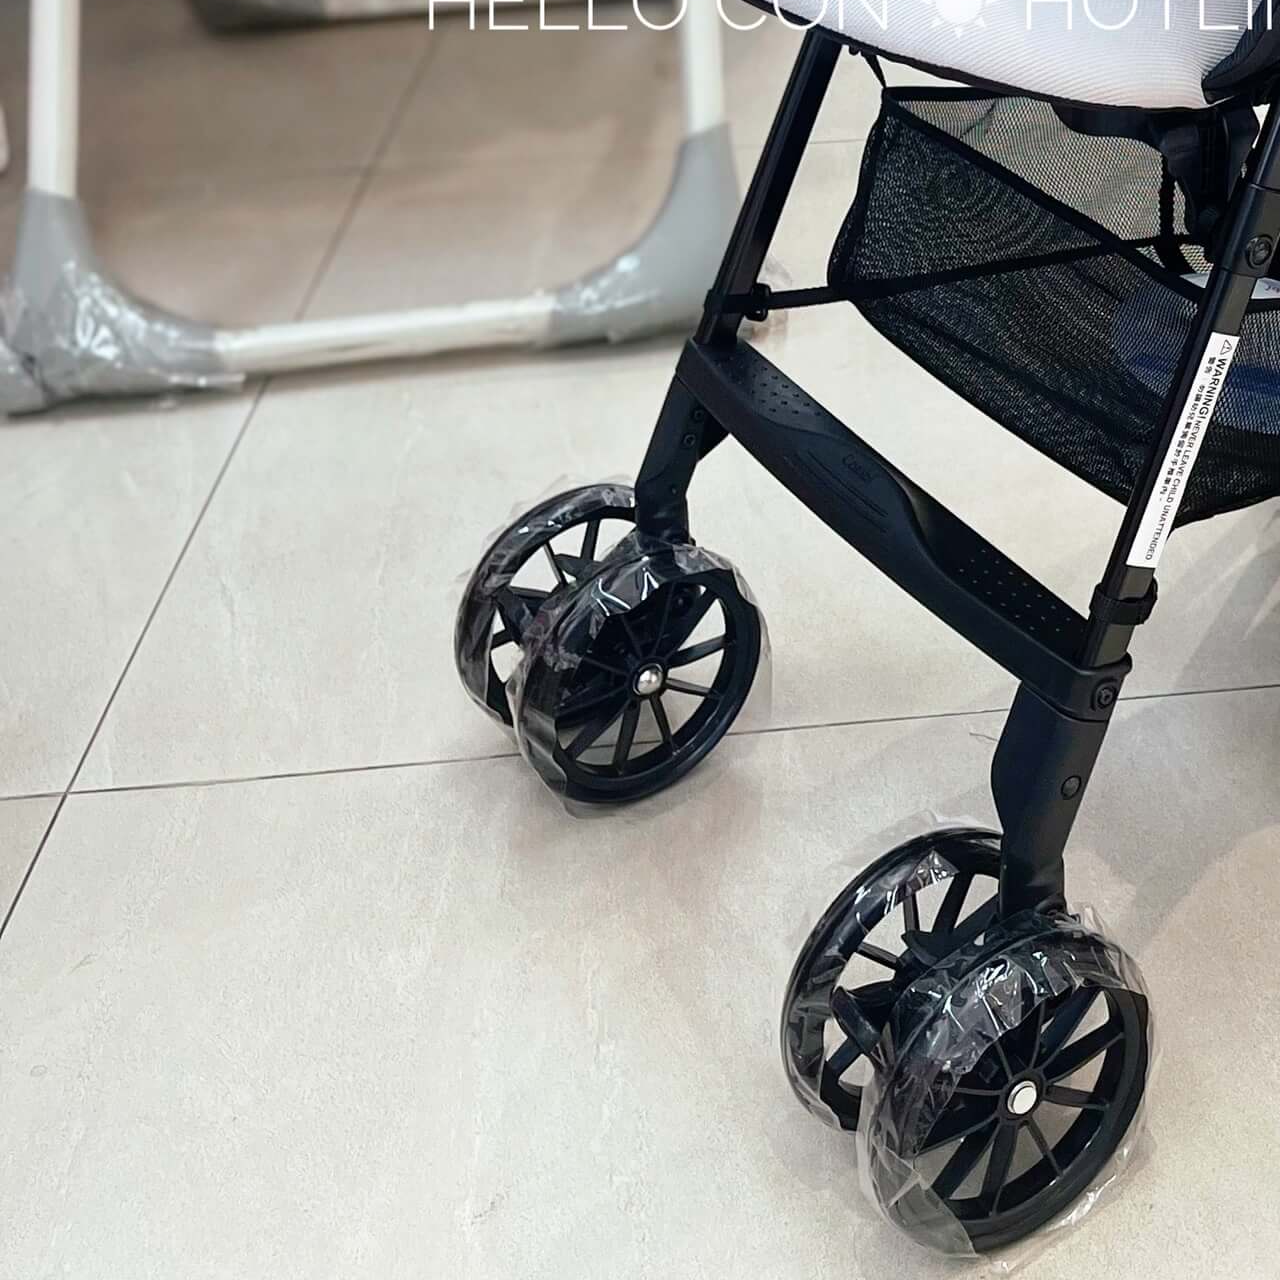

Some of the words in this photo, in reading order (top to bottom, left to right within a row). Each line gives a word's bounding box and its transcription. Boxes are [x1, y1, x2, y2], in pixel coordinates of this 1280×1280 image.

[1198, 357, 1228, 420] WARNING!
[1186, 419, 1202, 450] NEVER
[1174, 448, 1193, 479] LEAVE
[1165, 477, 1182, 504] CHILD
[1144, 504, 1173, 561] UNATTENDED
